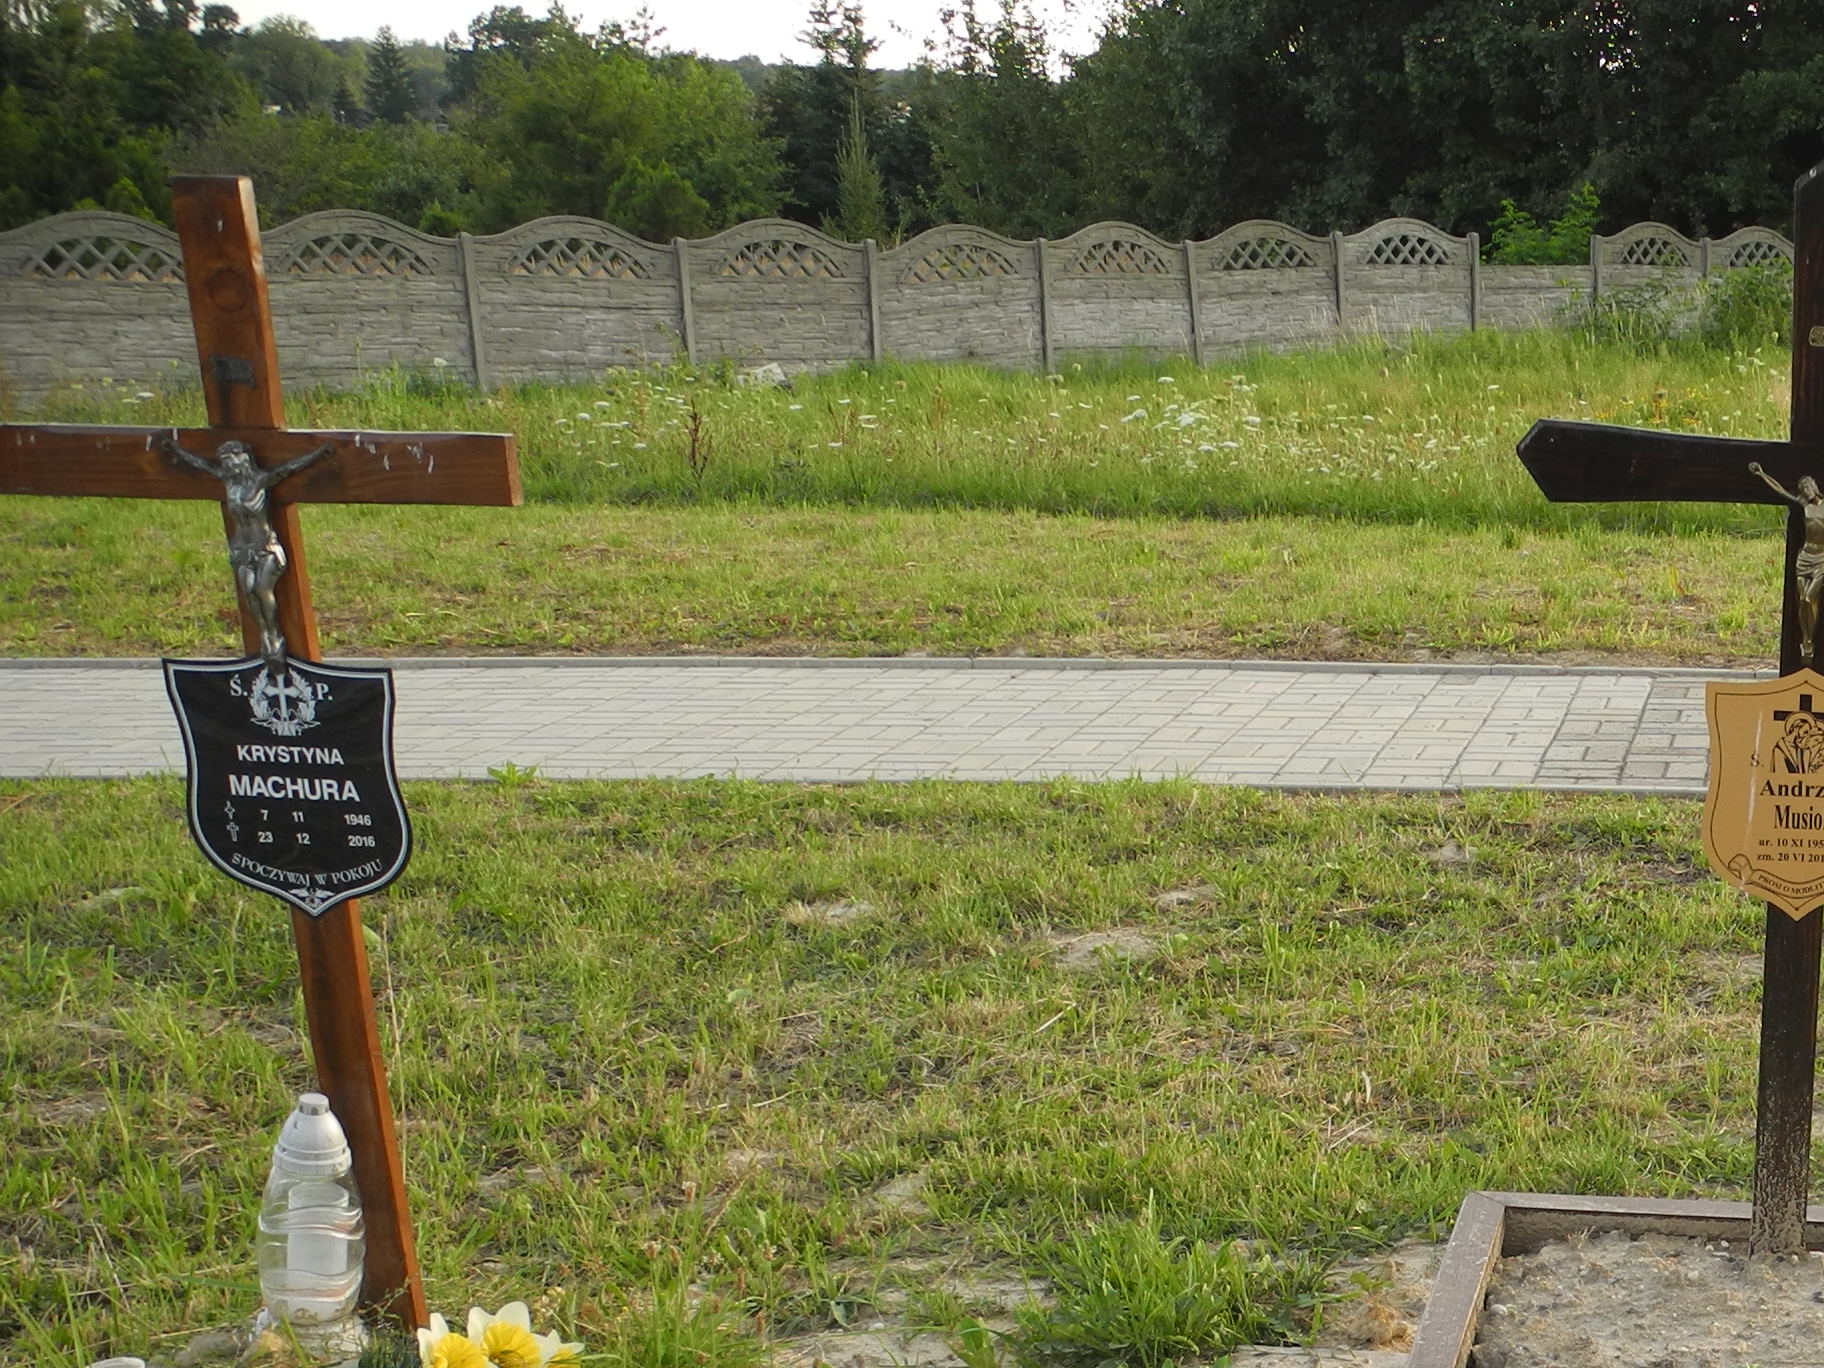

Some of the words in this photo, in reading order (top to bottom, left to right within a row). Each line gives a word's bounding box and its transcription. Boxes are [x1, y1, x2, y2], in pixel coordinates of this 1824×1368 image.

[315, 682, 333, 700] P.
[236, 744, 345, 765] KRYSTYNA
[228, 774, 361, 802] MACHURA
[260, 809, 269, 821] 7
[292, 811, 305, 823] 11
[343, 814, 372, 826] 1946
[257, 831, 274, 844] 23
[296, 832, 311, 845] 12
[347, 835, 376, 848] 2016
[1777, 838, 1789, 847] 10
[1790, 838, 1804, 848] XI
[1777, 852, 1790, 862] 20
[1792, 852, 1805, 862] VI
[231, 852, 311, 887] SPOCZYWAJ
[314, 873, 328, 886] W
[330, 858, 384, 885] POKOJU
